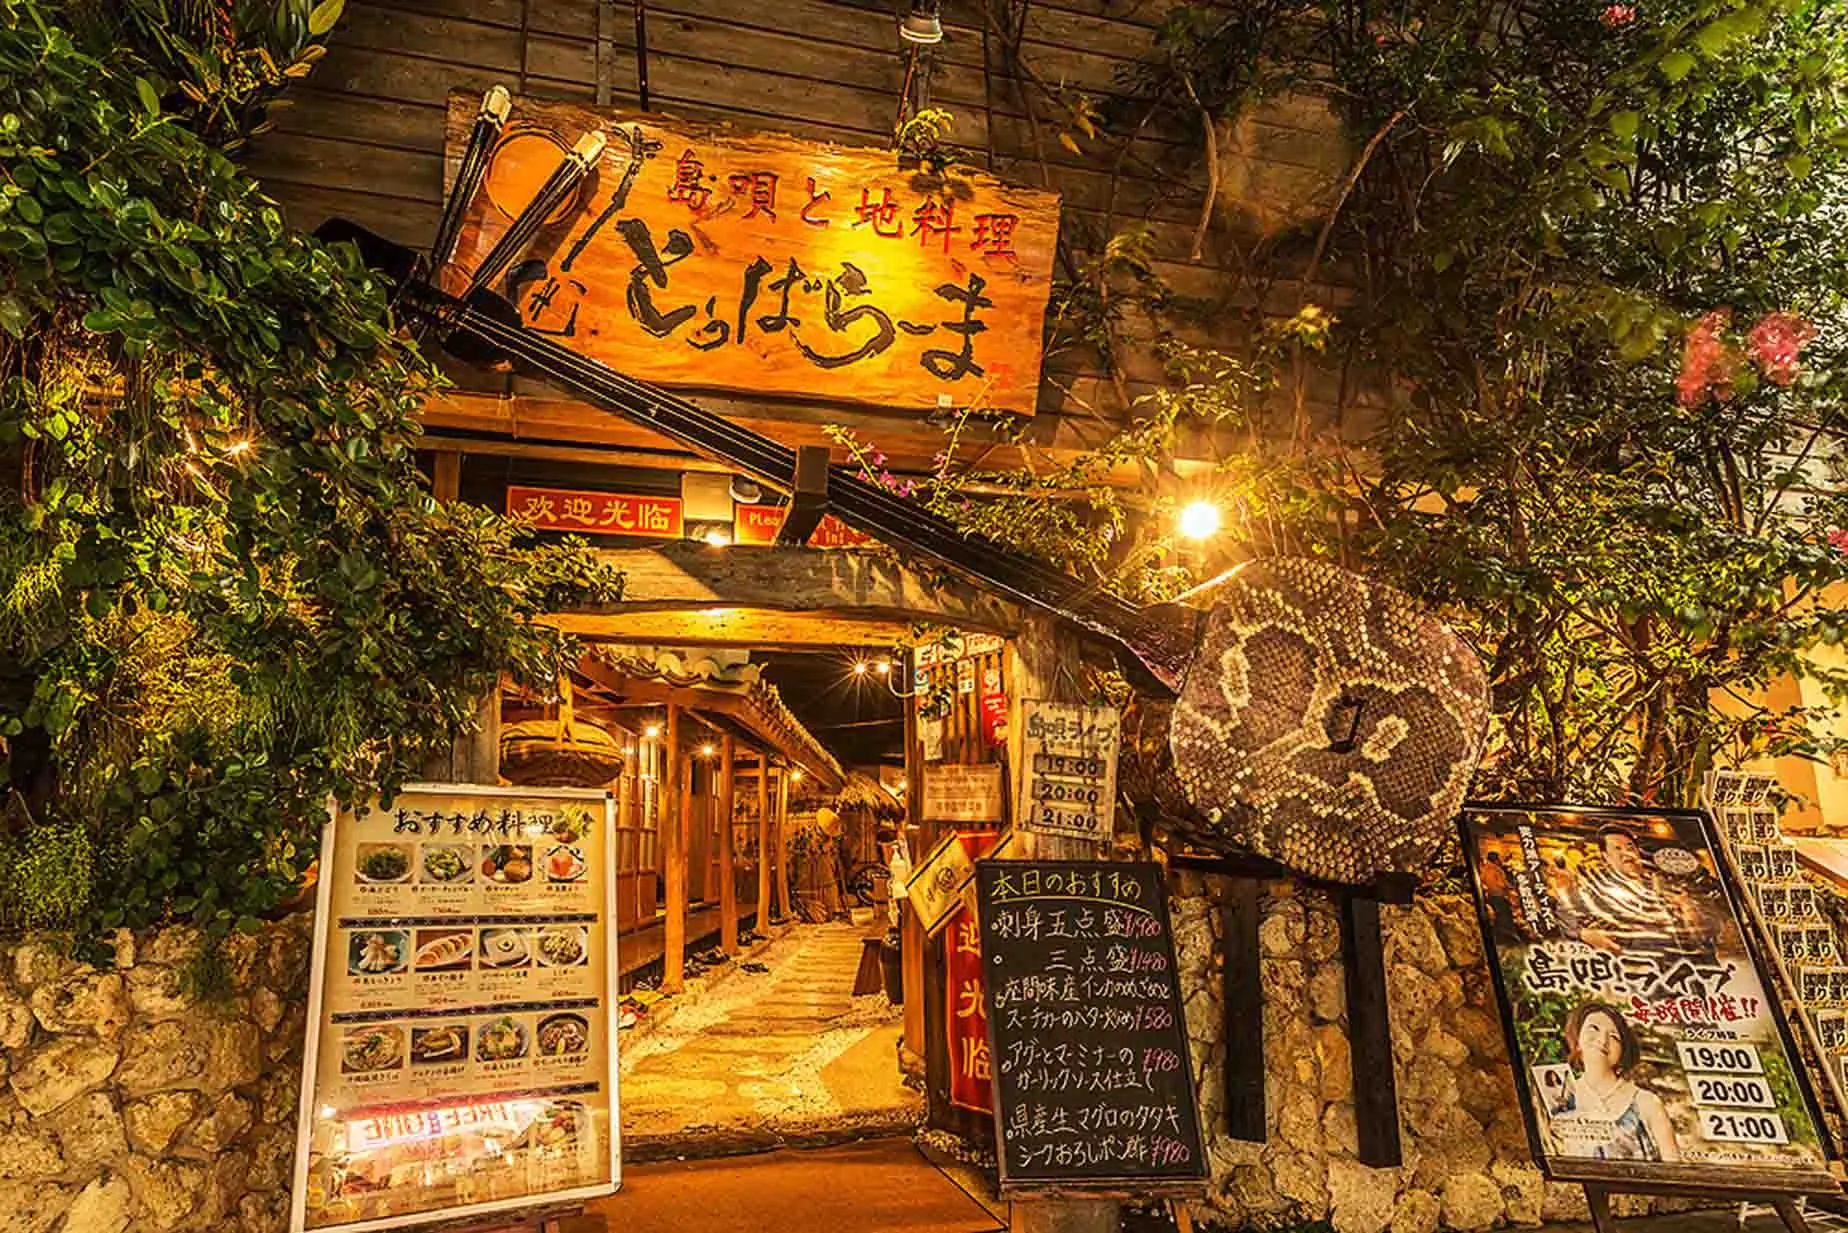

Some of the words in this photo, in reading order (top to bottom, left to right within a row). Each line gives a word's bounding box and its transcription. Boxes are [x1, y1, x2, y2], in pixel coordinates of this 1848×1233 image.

[667, 148, 1021, 260] 島唄と地料理
[525, 495, 673, 533] 欢迎光临
[1048, 755, 1098, 776] 19:00
[1040, 782, 1098, 803] 20:00
[1042, 807, 1098, 830] 21:00
[991, 869, 1142, 900] 本日のおすすめ
[998, 905, 1129, 941] 刺身五点盛
[1044, 943, 1134, 974] 三点盛
[1526, 946, 1737, 996] 島唄ライブ
[1135, 1003, 1174, 1031] ¥580
[1687, 1044, 1752, 1070] 19:00
[1697, 1079, 1764, 1104] 20:00
[1708, 1114, 1777, 1139] 21:00
